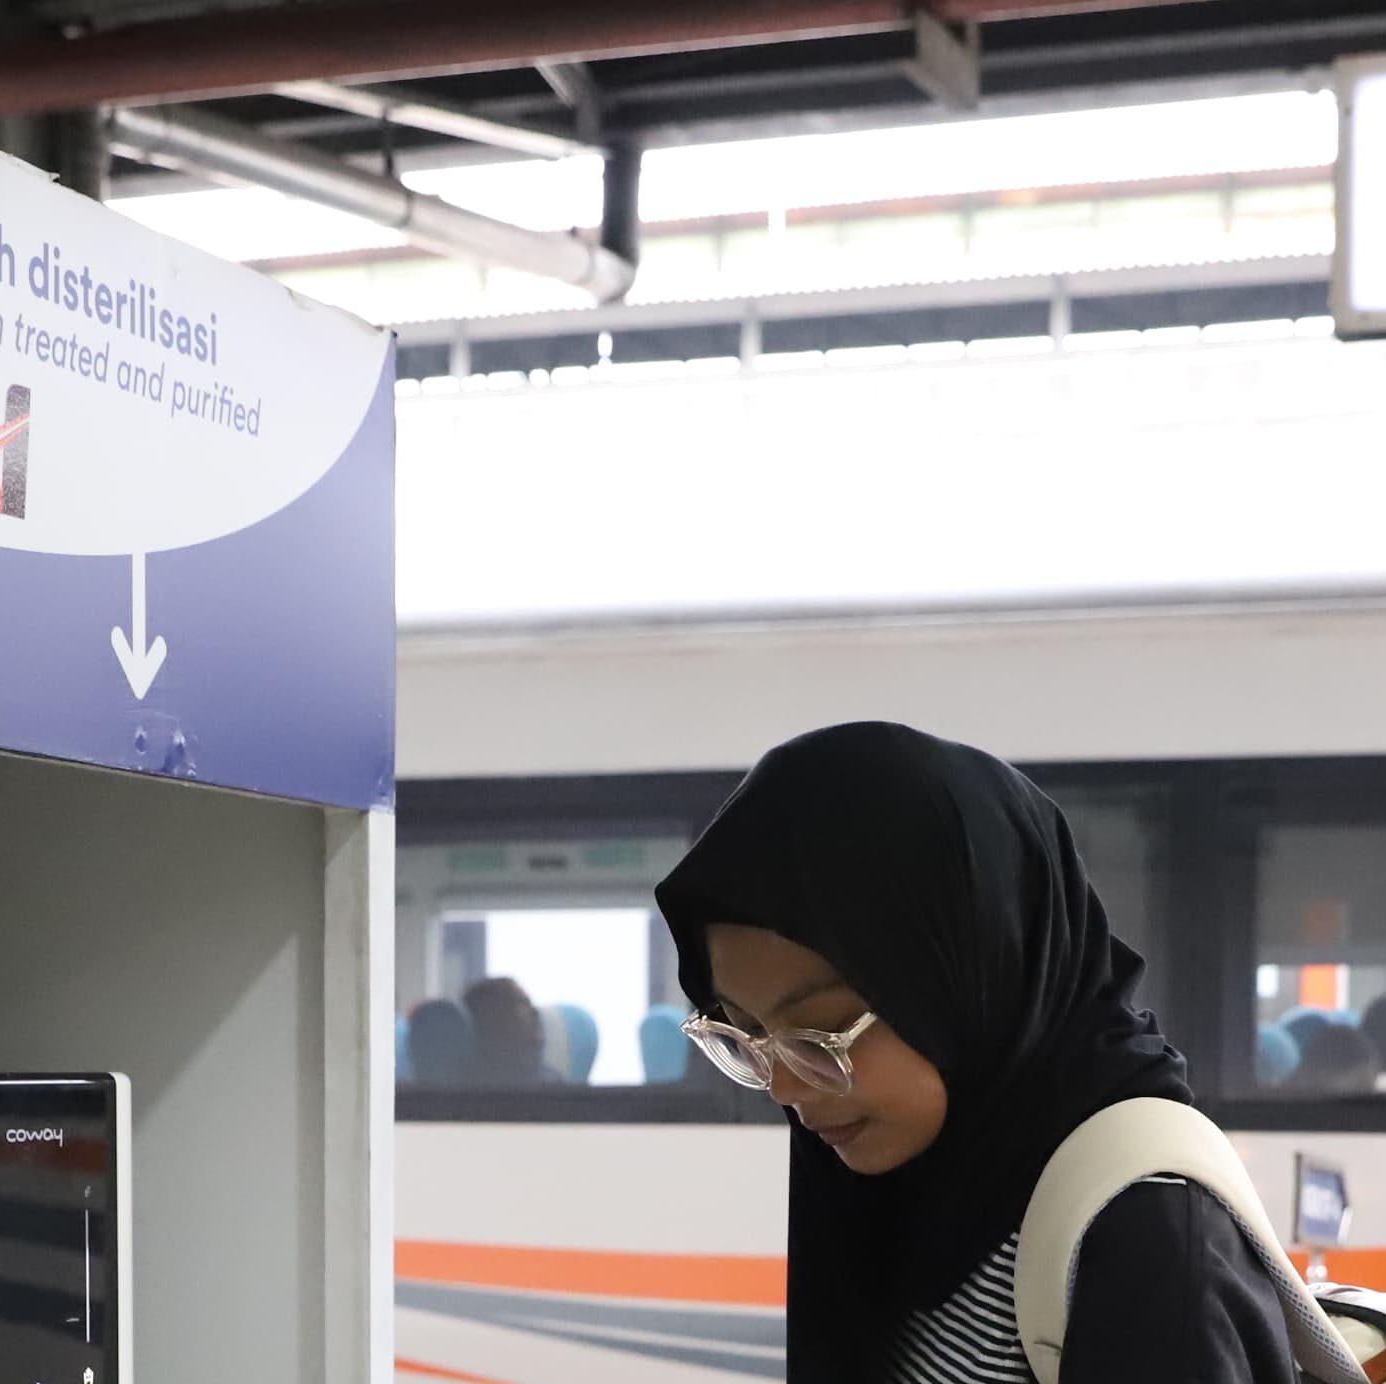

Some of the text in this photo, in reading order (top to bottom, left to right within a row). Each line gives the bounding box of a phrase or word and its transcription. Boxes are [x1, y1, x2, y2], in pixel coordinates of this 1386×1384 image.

[28, 242, 219, 366] disterilisasi
[14, 312, 111, 384] treated
[116, 362, 165, 403] and
[170, 376, 263, 438] purified
[5, 1127, 64, 1148] coway
